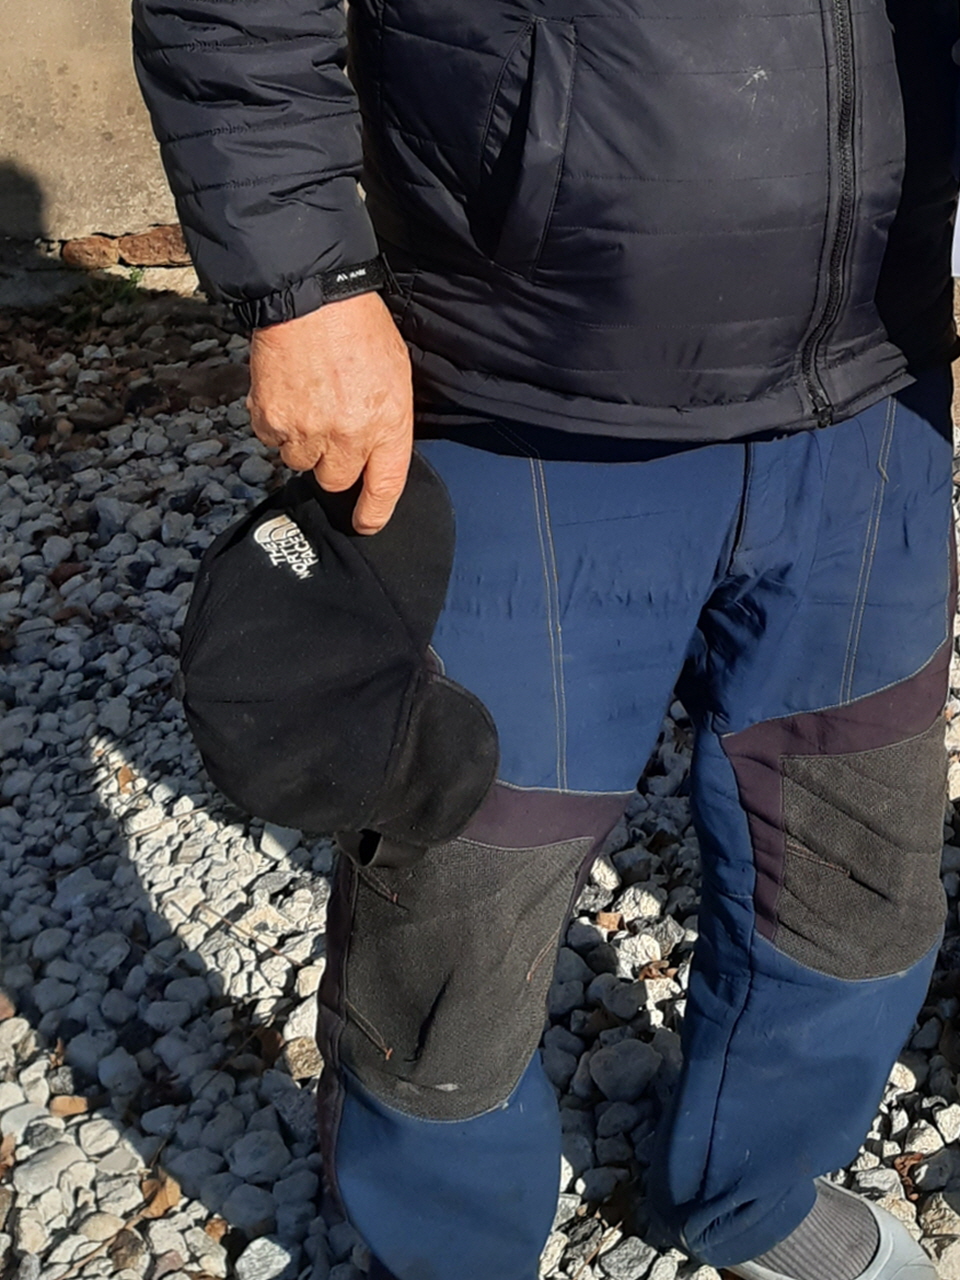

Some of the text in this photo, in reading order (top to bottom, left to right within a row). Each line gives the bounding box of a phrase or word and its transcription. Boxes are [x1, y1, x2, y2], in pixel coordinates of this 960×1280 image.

[260, 541, 287, 567] THE
[276, 538, 314, 580] NORTH
[290, 533, 319, 567] FACE
